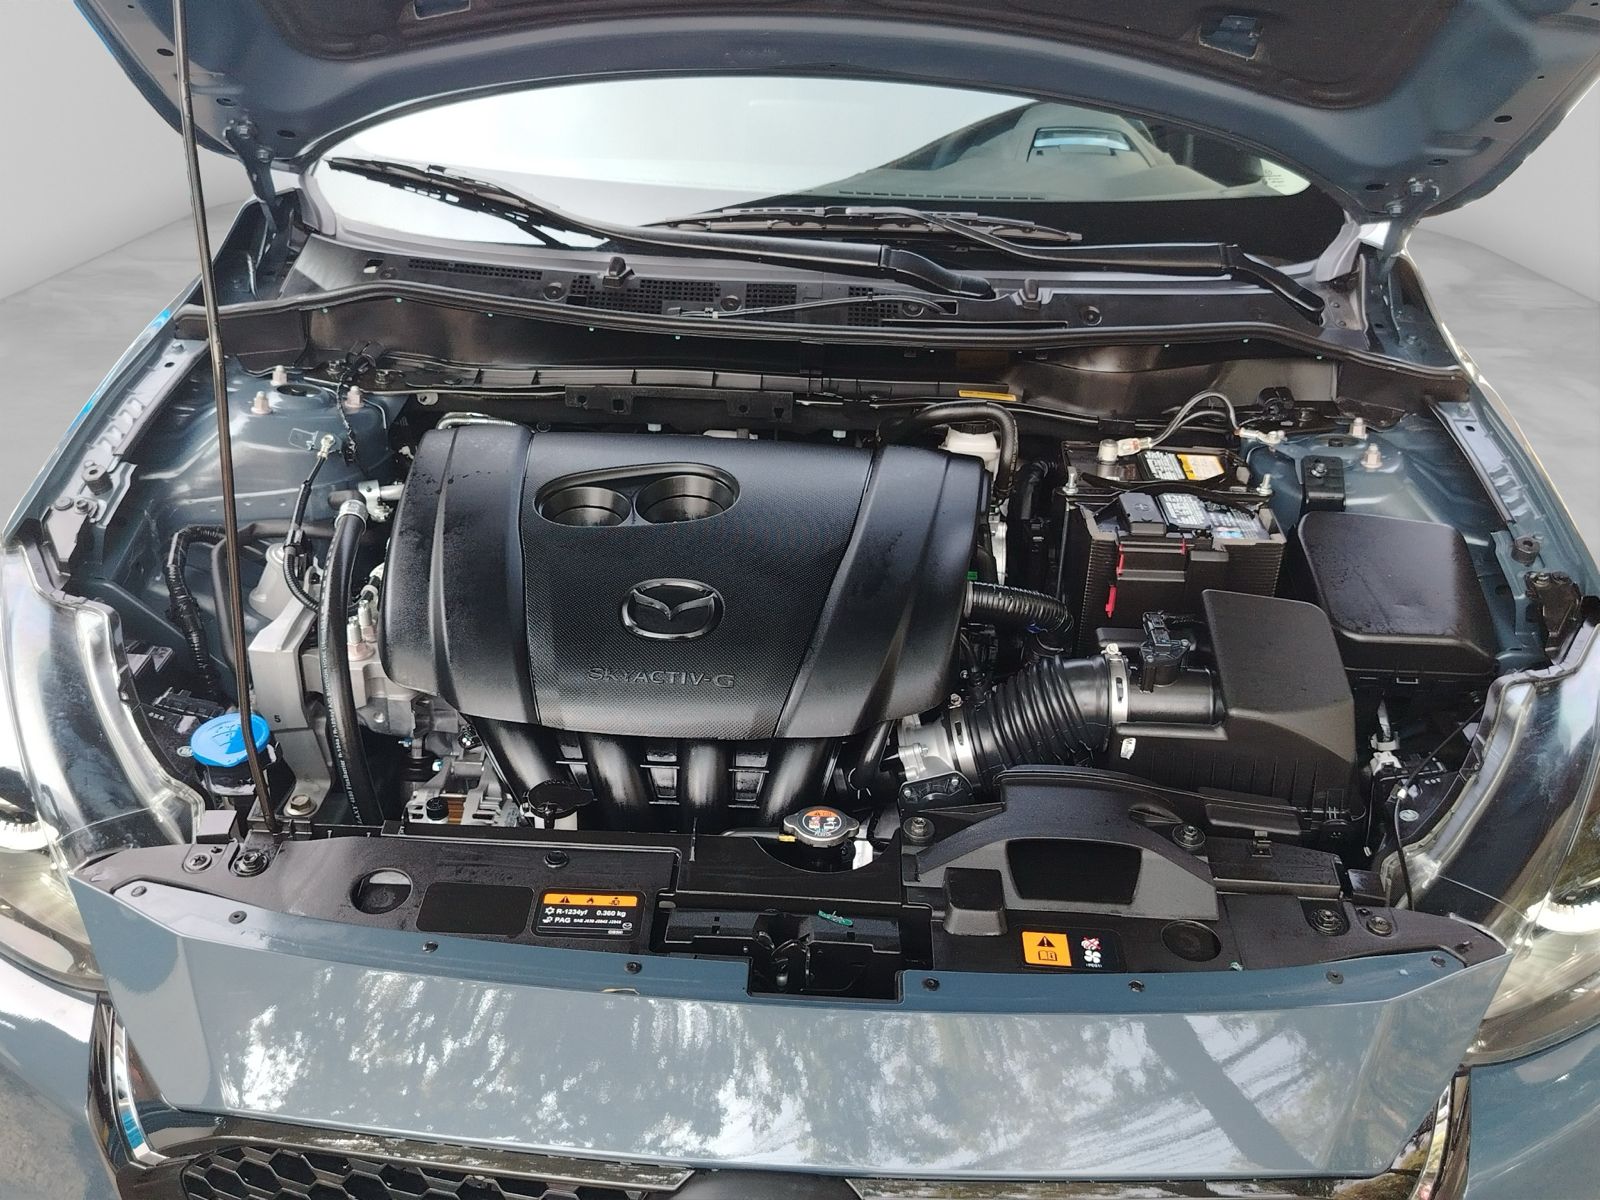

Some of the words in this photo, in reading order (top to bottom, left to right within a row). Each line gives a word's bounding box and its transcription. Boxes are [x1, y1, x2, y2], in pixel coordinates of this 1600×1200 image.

[588, 667, 735, 688] SKYACTIV-G
[274, 714, 281, 723] 5
[556, 908, 588, 916] R-1234yf
[617, 910, 627, 918] kg
